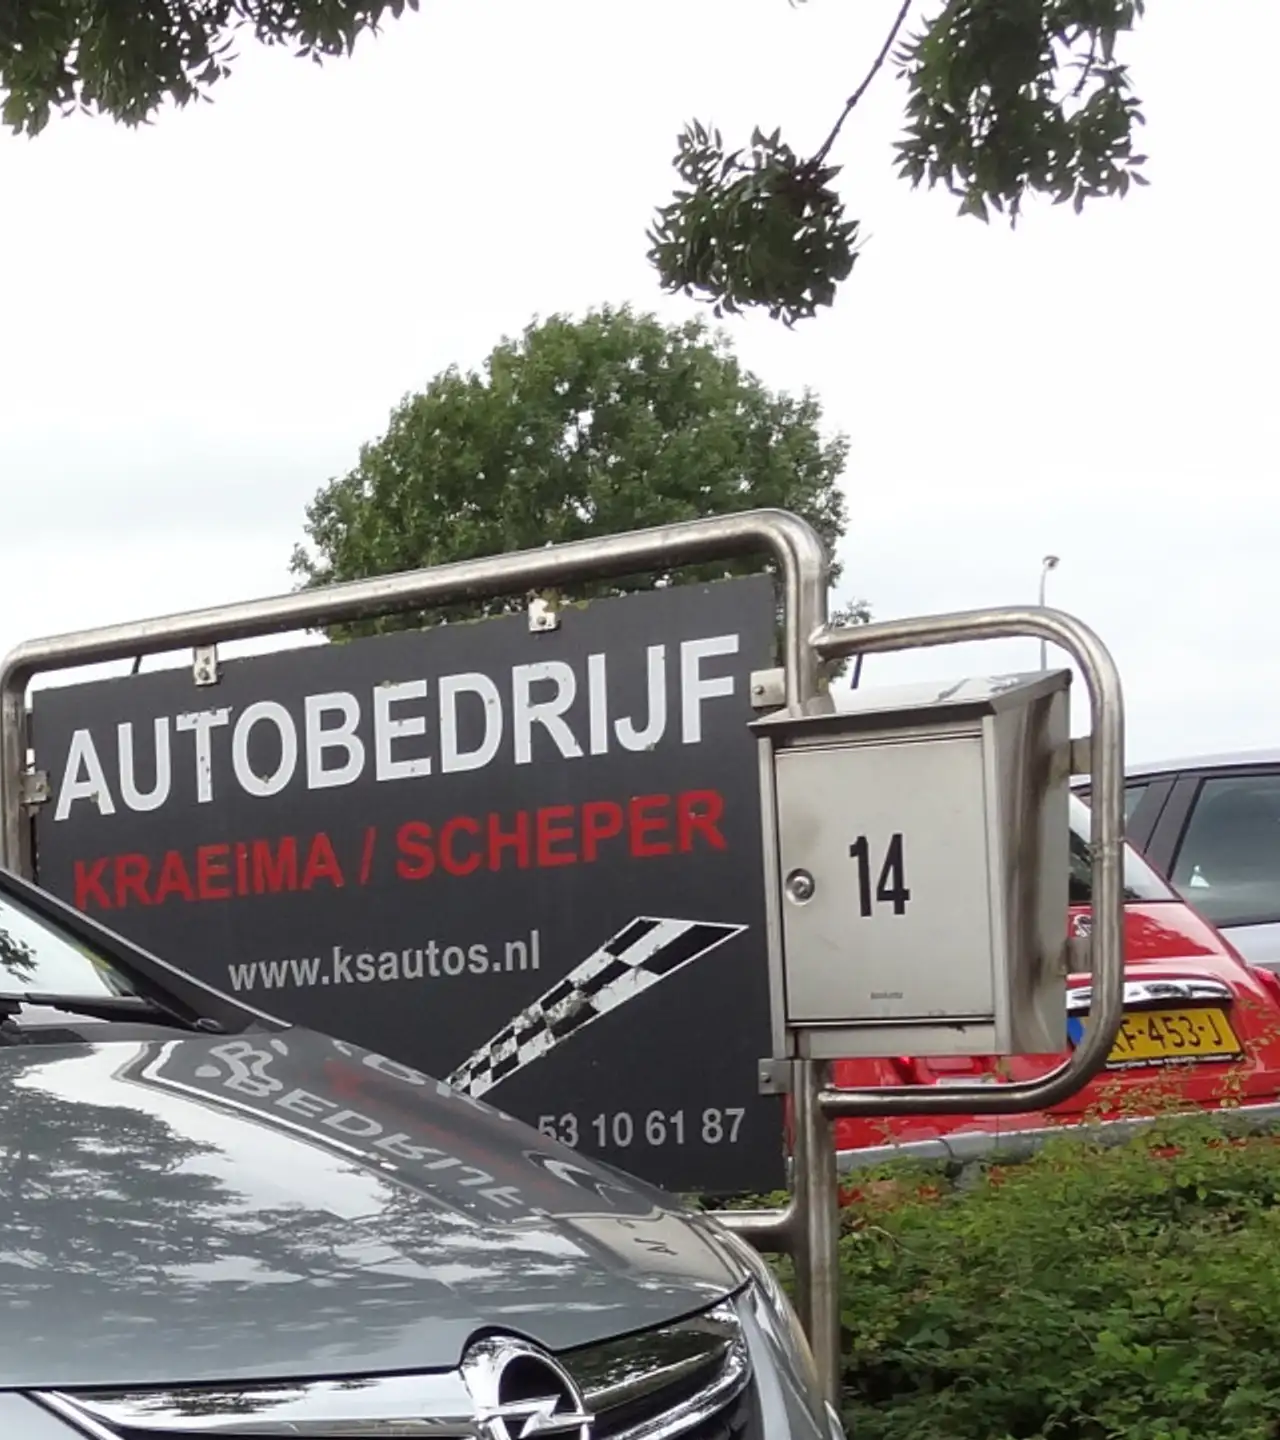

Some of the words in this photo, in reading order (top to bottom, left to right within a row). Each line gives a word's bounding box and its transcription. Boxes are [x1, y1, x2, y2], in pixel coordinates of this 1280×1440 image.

[53, 634, 740, 823] AUTOBEDRIJF
[358, 827, 378, 885] /
[395, 789, 728, 881] SCHEPER
[848, 833, 910, 918] 14
[227, 928, 542, 992] www.ksautos.nl
[592, 1112, 634, 1147] 10
[645, 1109, 685, 1145] 61
[701, 1107, 746, 1144] 87
